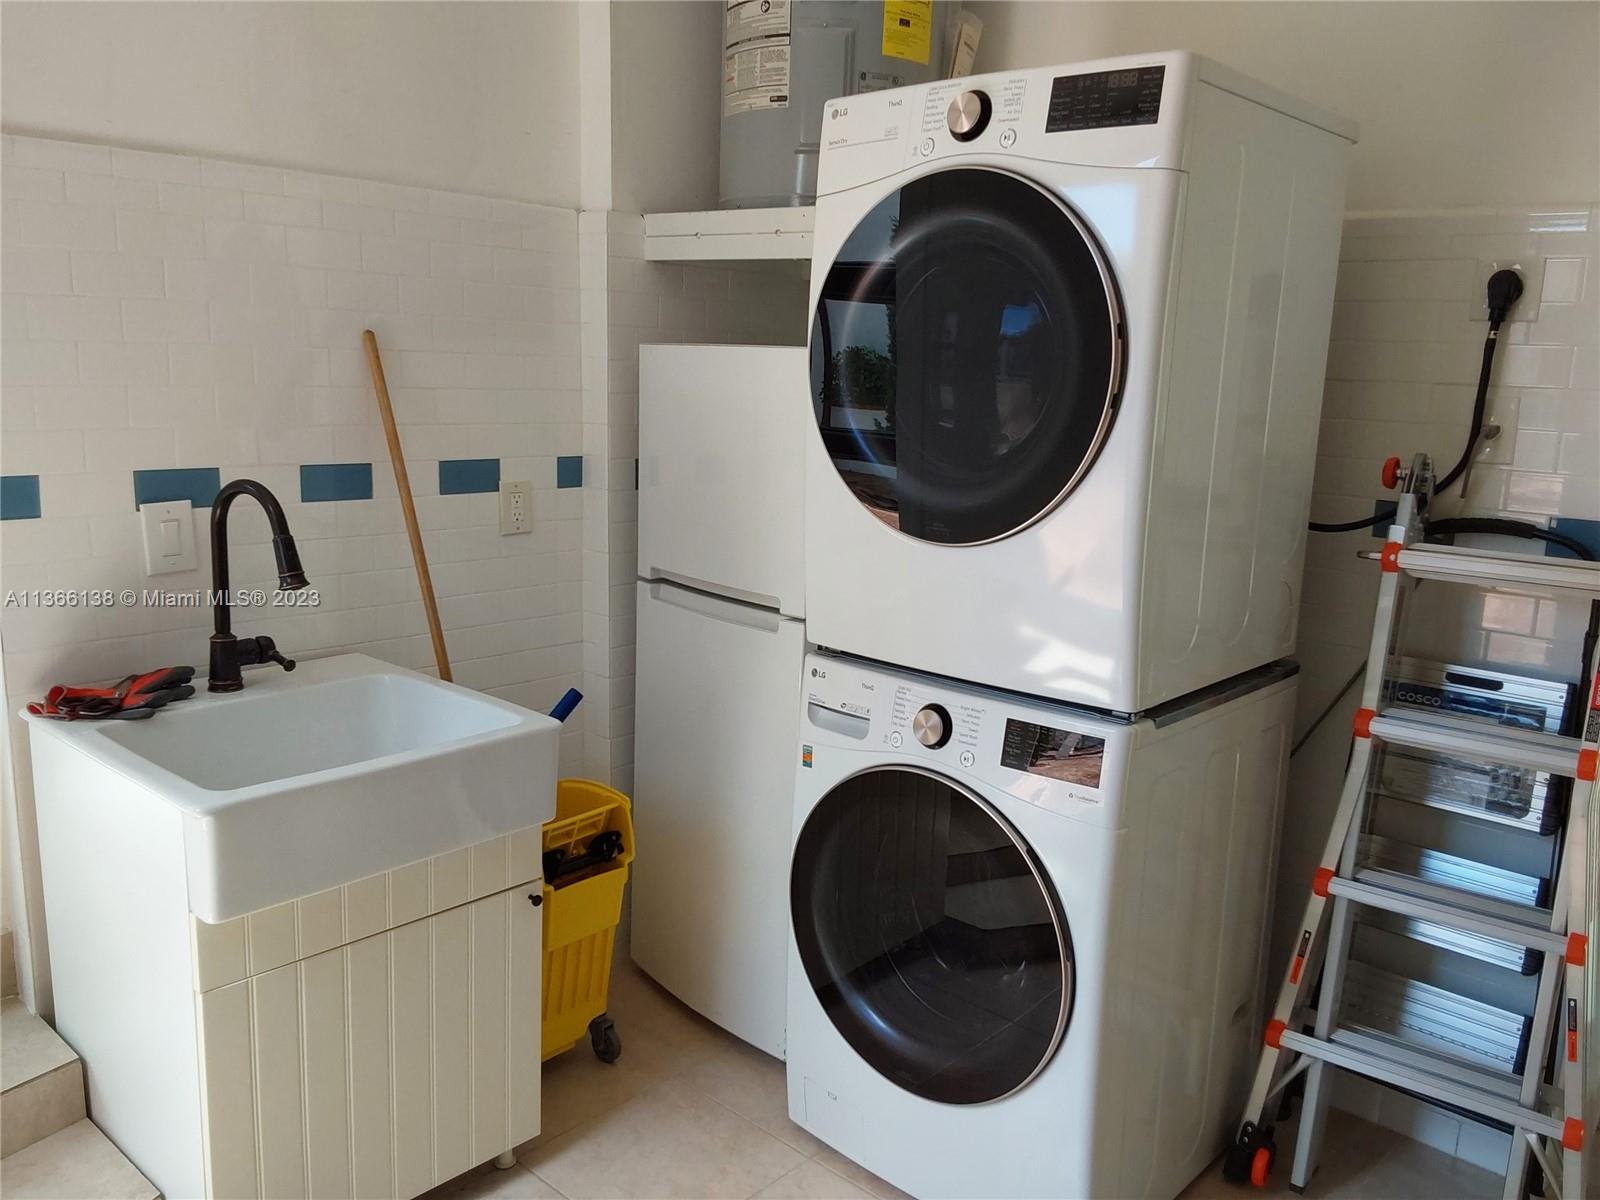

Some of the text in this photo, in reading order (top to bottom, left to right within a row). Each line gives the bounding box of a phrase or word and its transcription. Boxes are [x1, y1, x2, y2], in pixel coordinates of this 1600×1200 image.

[839, 108, 848, 117] LG
[818, 671, 826, 679] LG
[1399, 691, 1441, 706] COSCO
